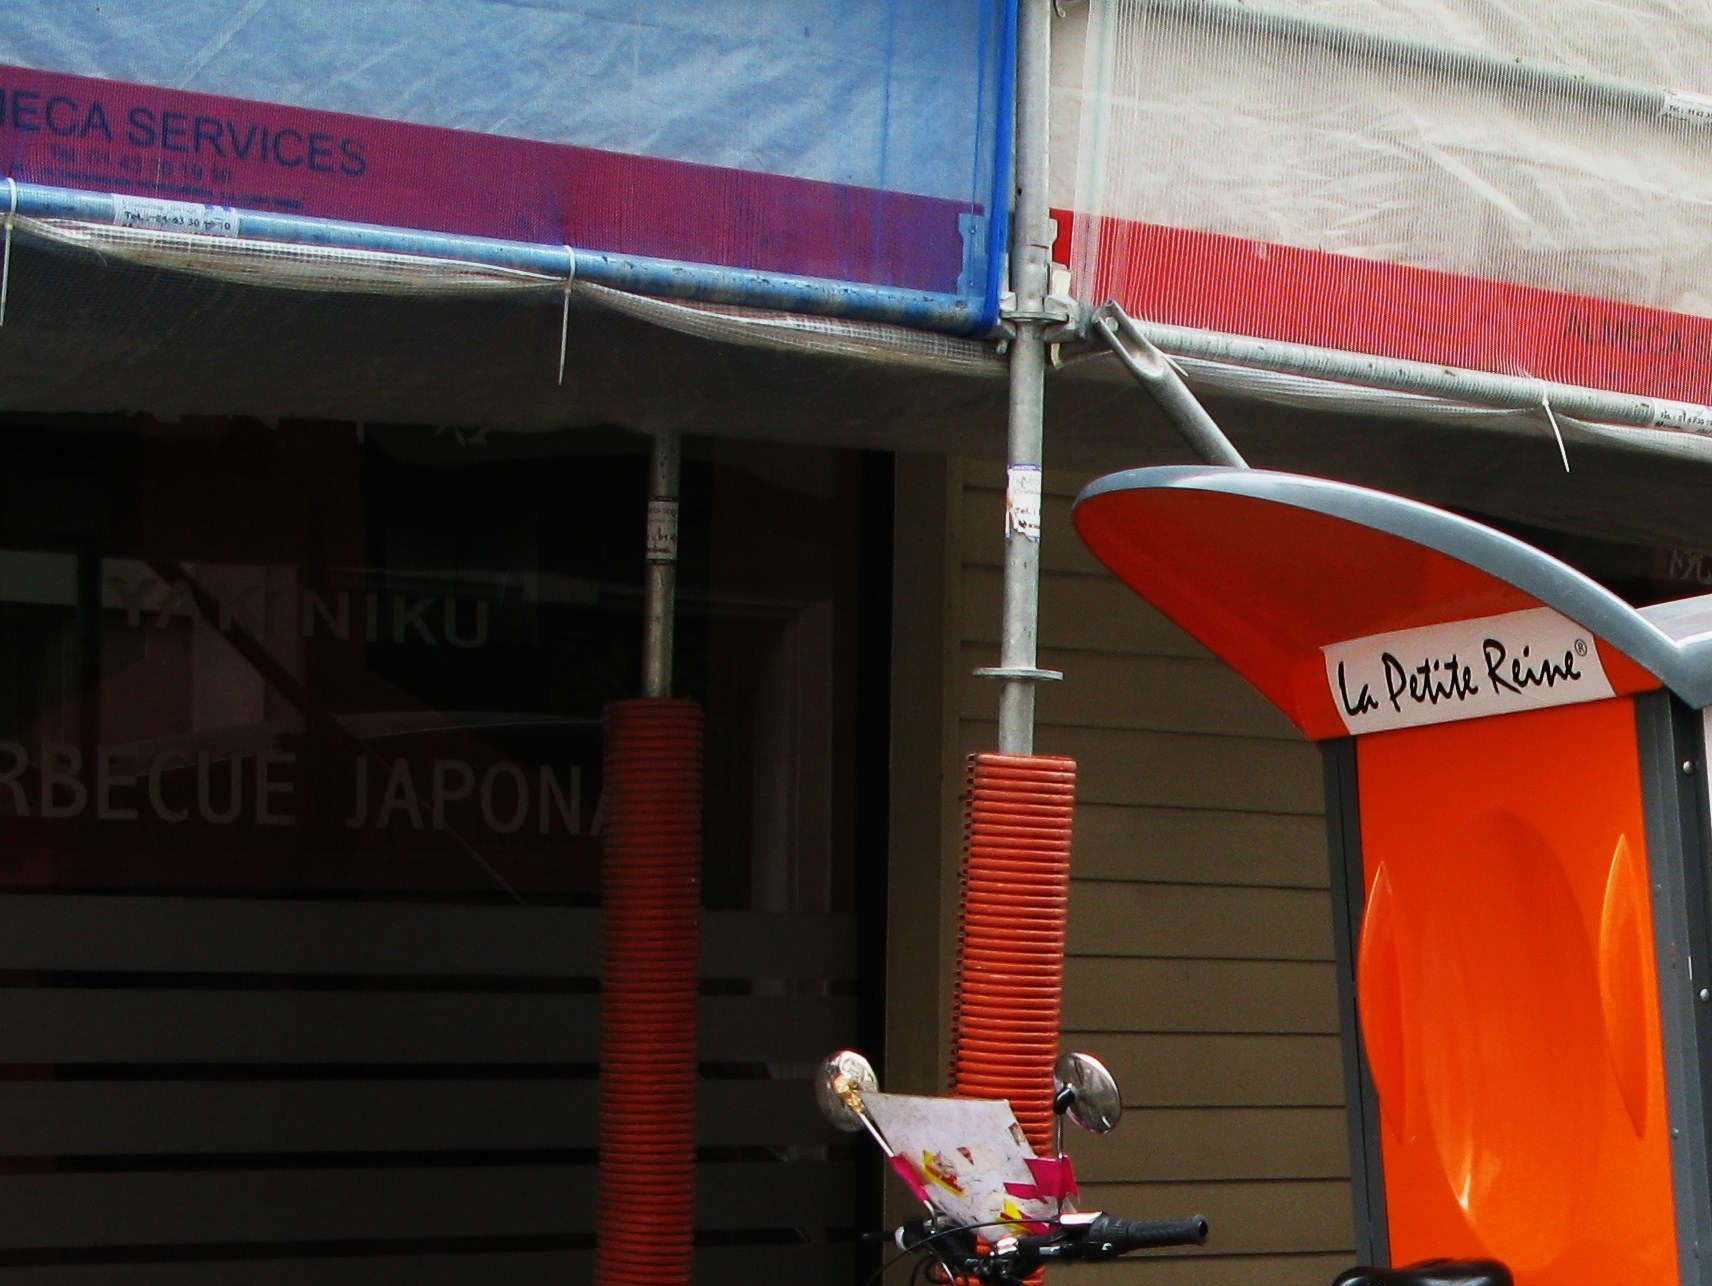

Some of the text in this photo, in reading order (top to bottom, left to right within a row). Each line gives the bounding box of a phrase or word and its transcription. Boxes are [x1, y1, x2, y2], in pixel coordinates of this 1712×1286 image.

[127, 106, 367, 177] SERVICES
[1564, 310, 1685, 360] ALMECA
[1337, 660, 1379, 716] La
[1381, 652, 1479, 713] Petite
